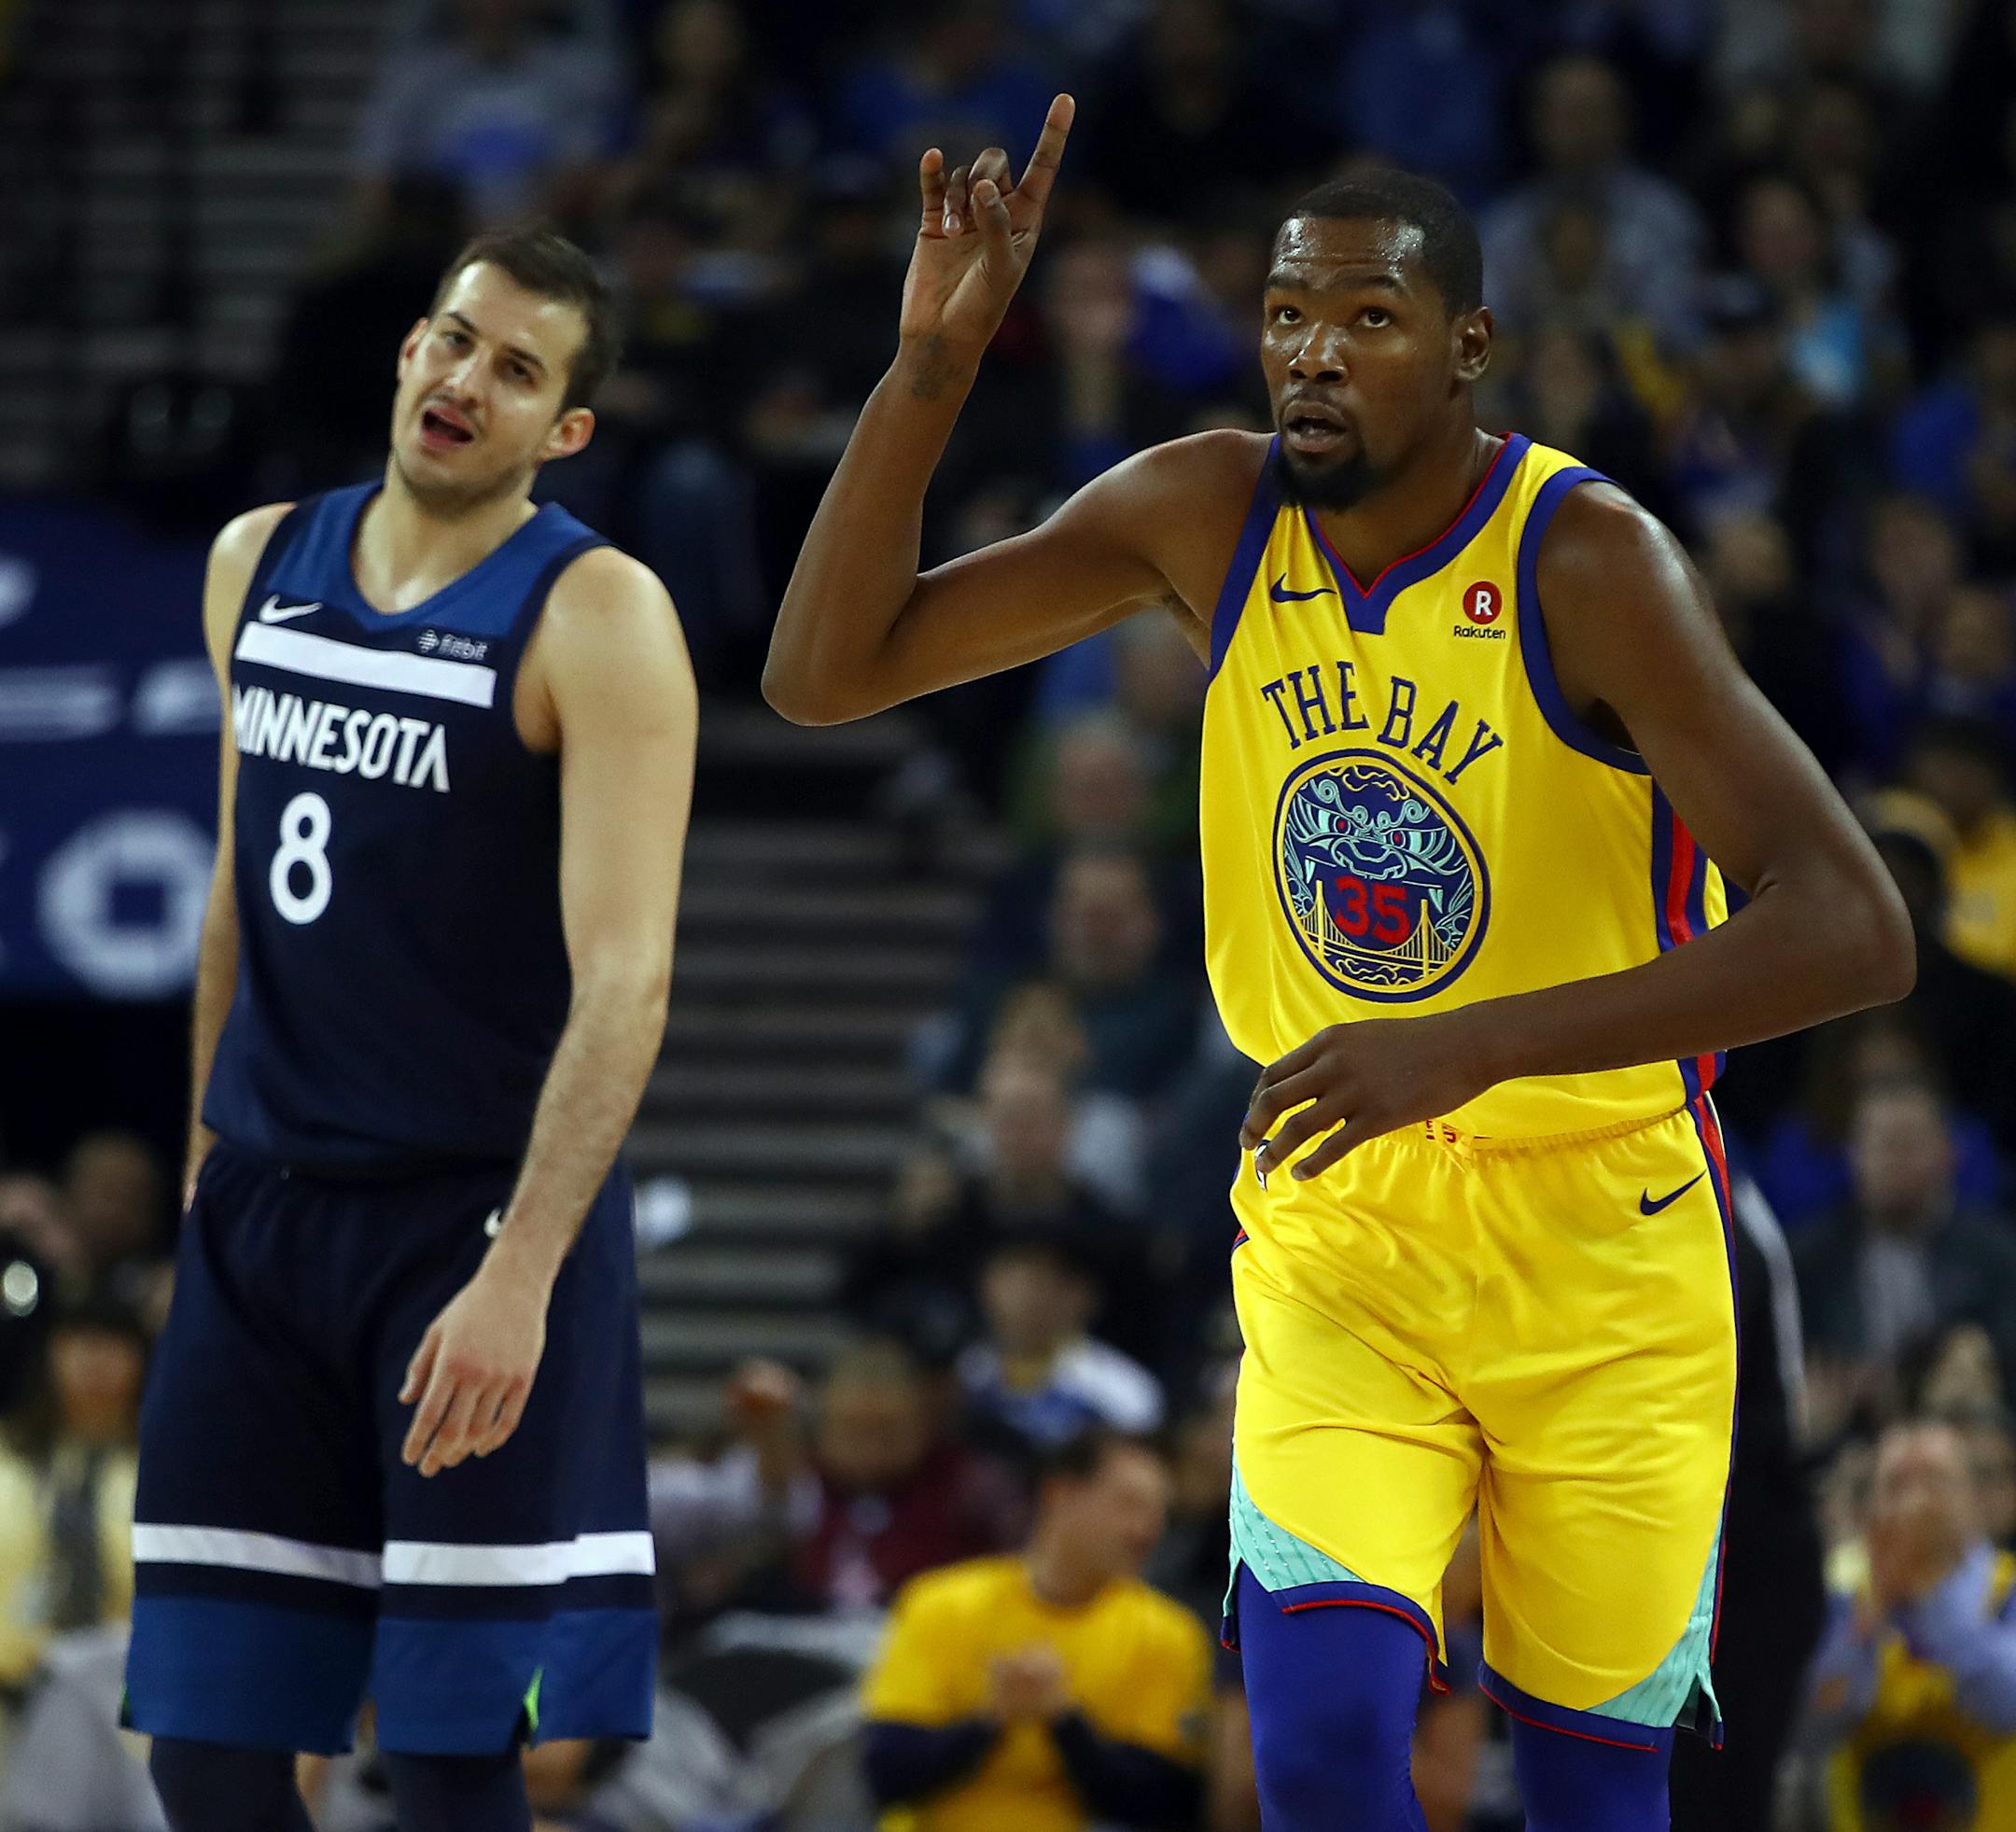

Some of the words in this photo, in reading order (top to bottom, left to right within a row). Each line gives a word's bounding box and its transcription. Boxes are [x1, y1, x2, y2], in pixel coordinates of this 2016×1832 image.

[1453, 625, 1506, 639] Rakuten
[1475, 590, 1493, 616] R
[231, 682, 451, 793] MINNESOTA
[1260, 660, 1370, 750] THE
[1376, 675, 1505, 786] BAY
[268, 790, 333, 926] 8
[1335, 875, 1412, 945] 35
